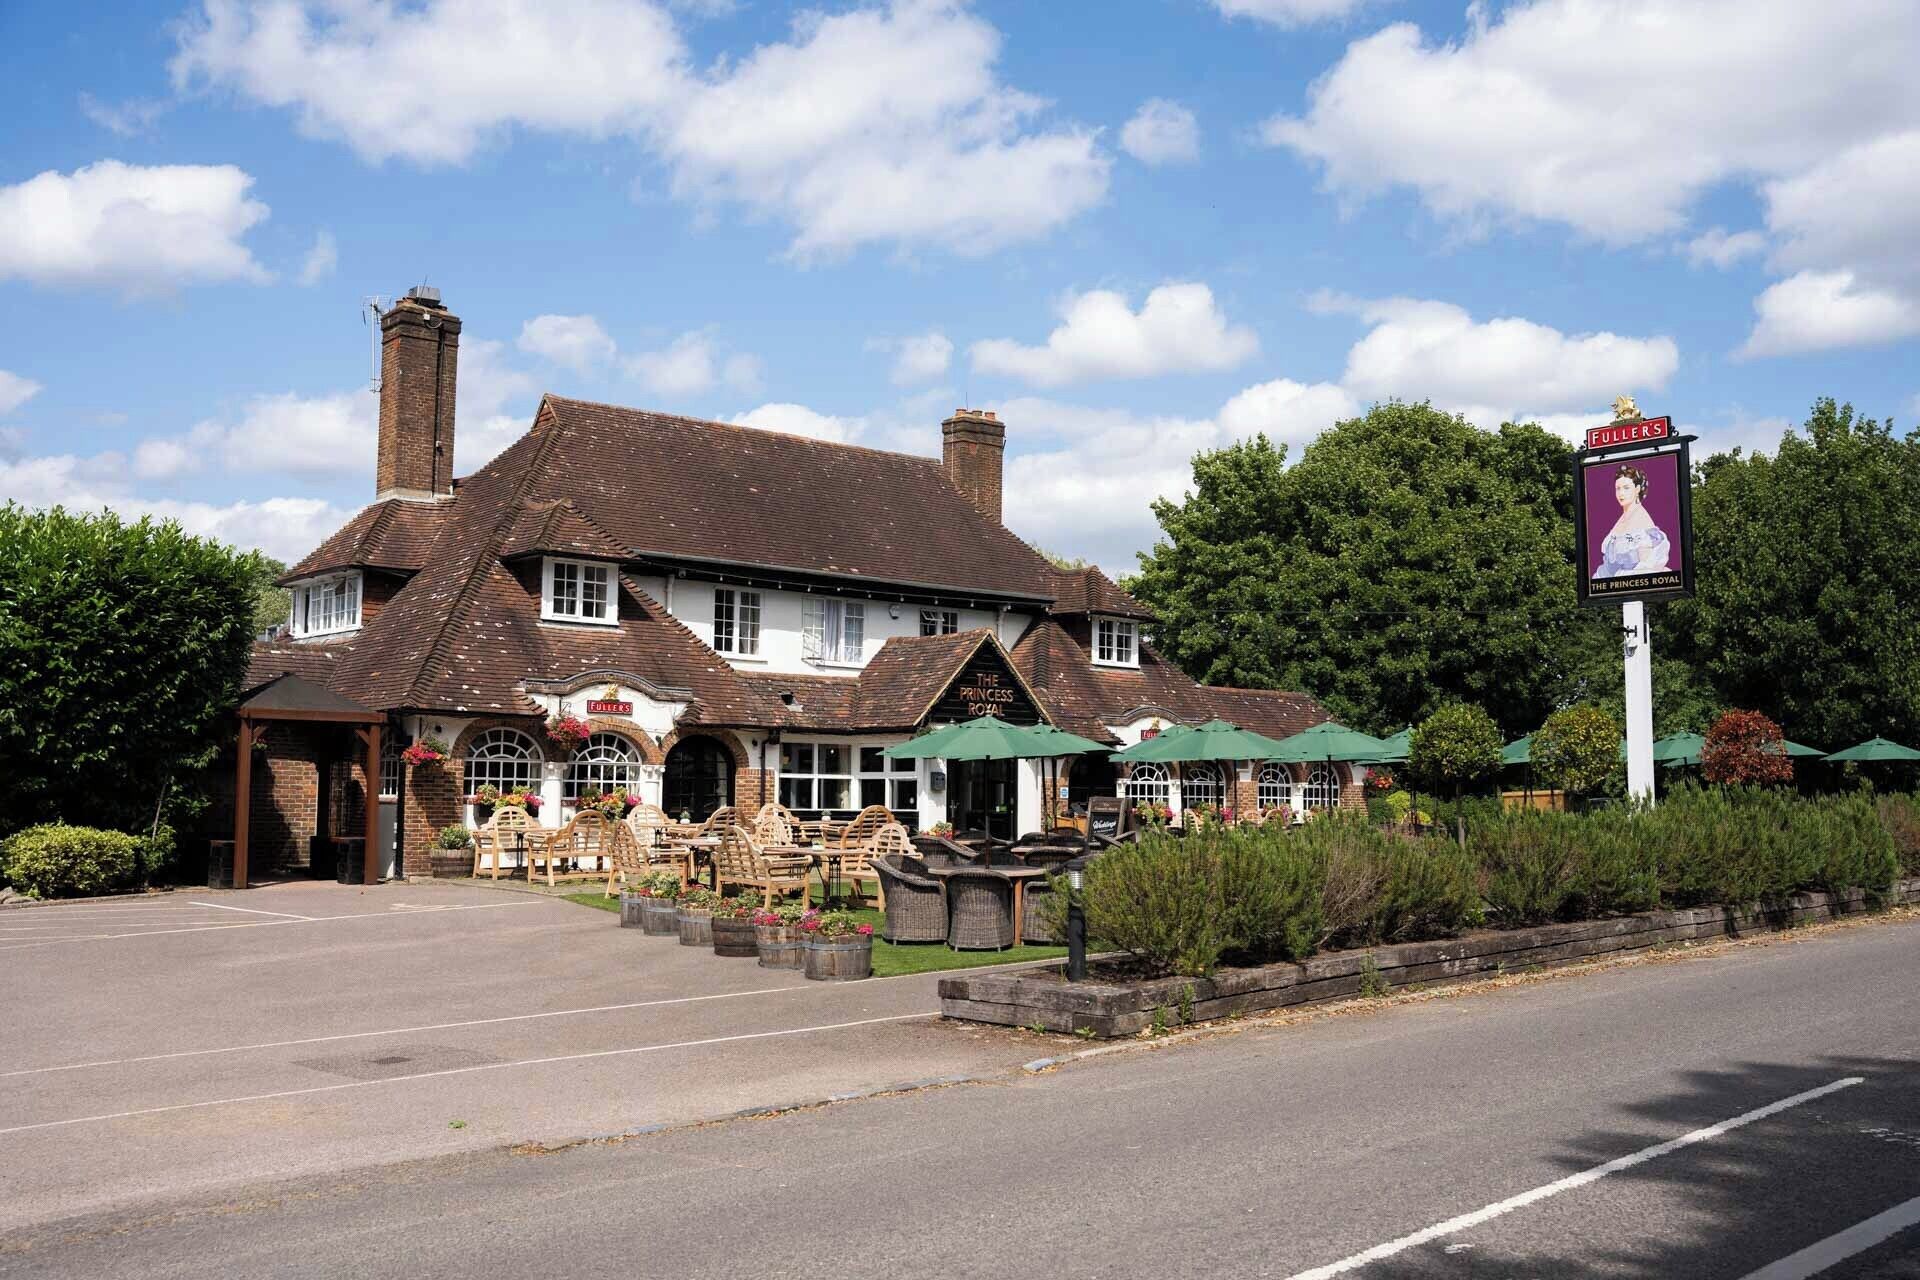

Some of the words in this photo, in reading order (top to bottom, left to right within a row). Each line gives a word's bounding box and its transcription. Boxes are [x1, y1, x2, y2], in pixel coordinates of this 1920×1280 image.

[1592, 423, 1662, 444] FULLER'S
[1591, 582, 1607, 591] THE
[1610, 578, 1649, 590] PRINCESS
[1652, 575, 1680, 585] ROYAL
[977, 674, 998, 687] THE
[960, 687, 1013, 702] PRINCESS
[590, 701, 630, 712] FULLER'S
[968, 703, 1005, 717] ROYAL
